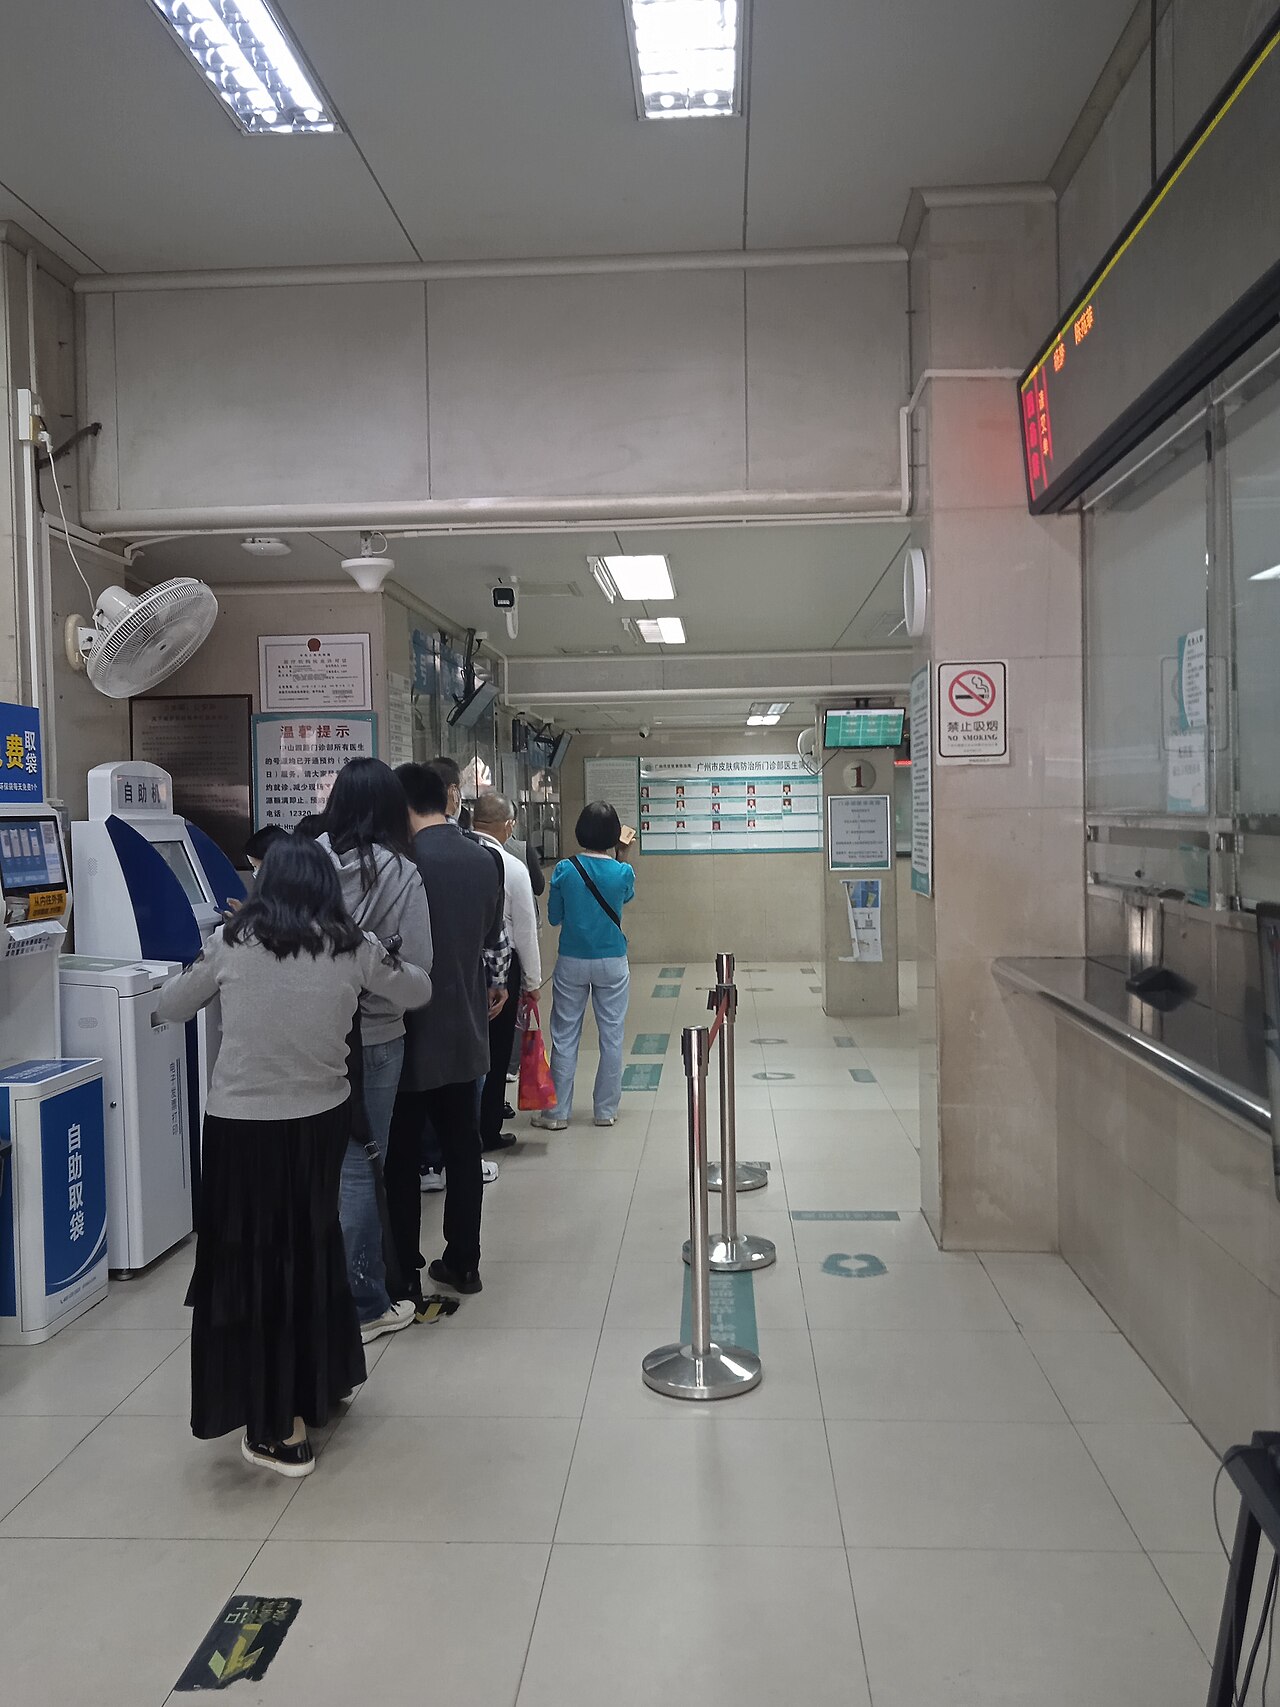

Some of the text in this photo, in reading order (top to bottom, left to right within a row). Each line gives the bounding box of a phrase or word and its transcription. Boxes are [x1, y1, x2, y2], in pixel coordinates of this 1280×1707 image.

[280, 724, 350, 739] 温馨提示
[947, 721, 999, 733] 禁止吸烟
[962, 733, 998, 741] SMOKING
[0, 733, 24, 769] 费
[24, 730, 38, 774] 取袋
[850, 765, 866, 788] 1
[124, 782, 161, 804] 自助机
[68, 1123, 84, 1242] 自助取袋
